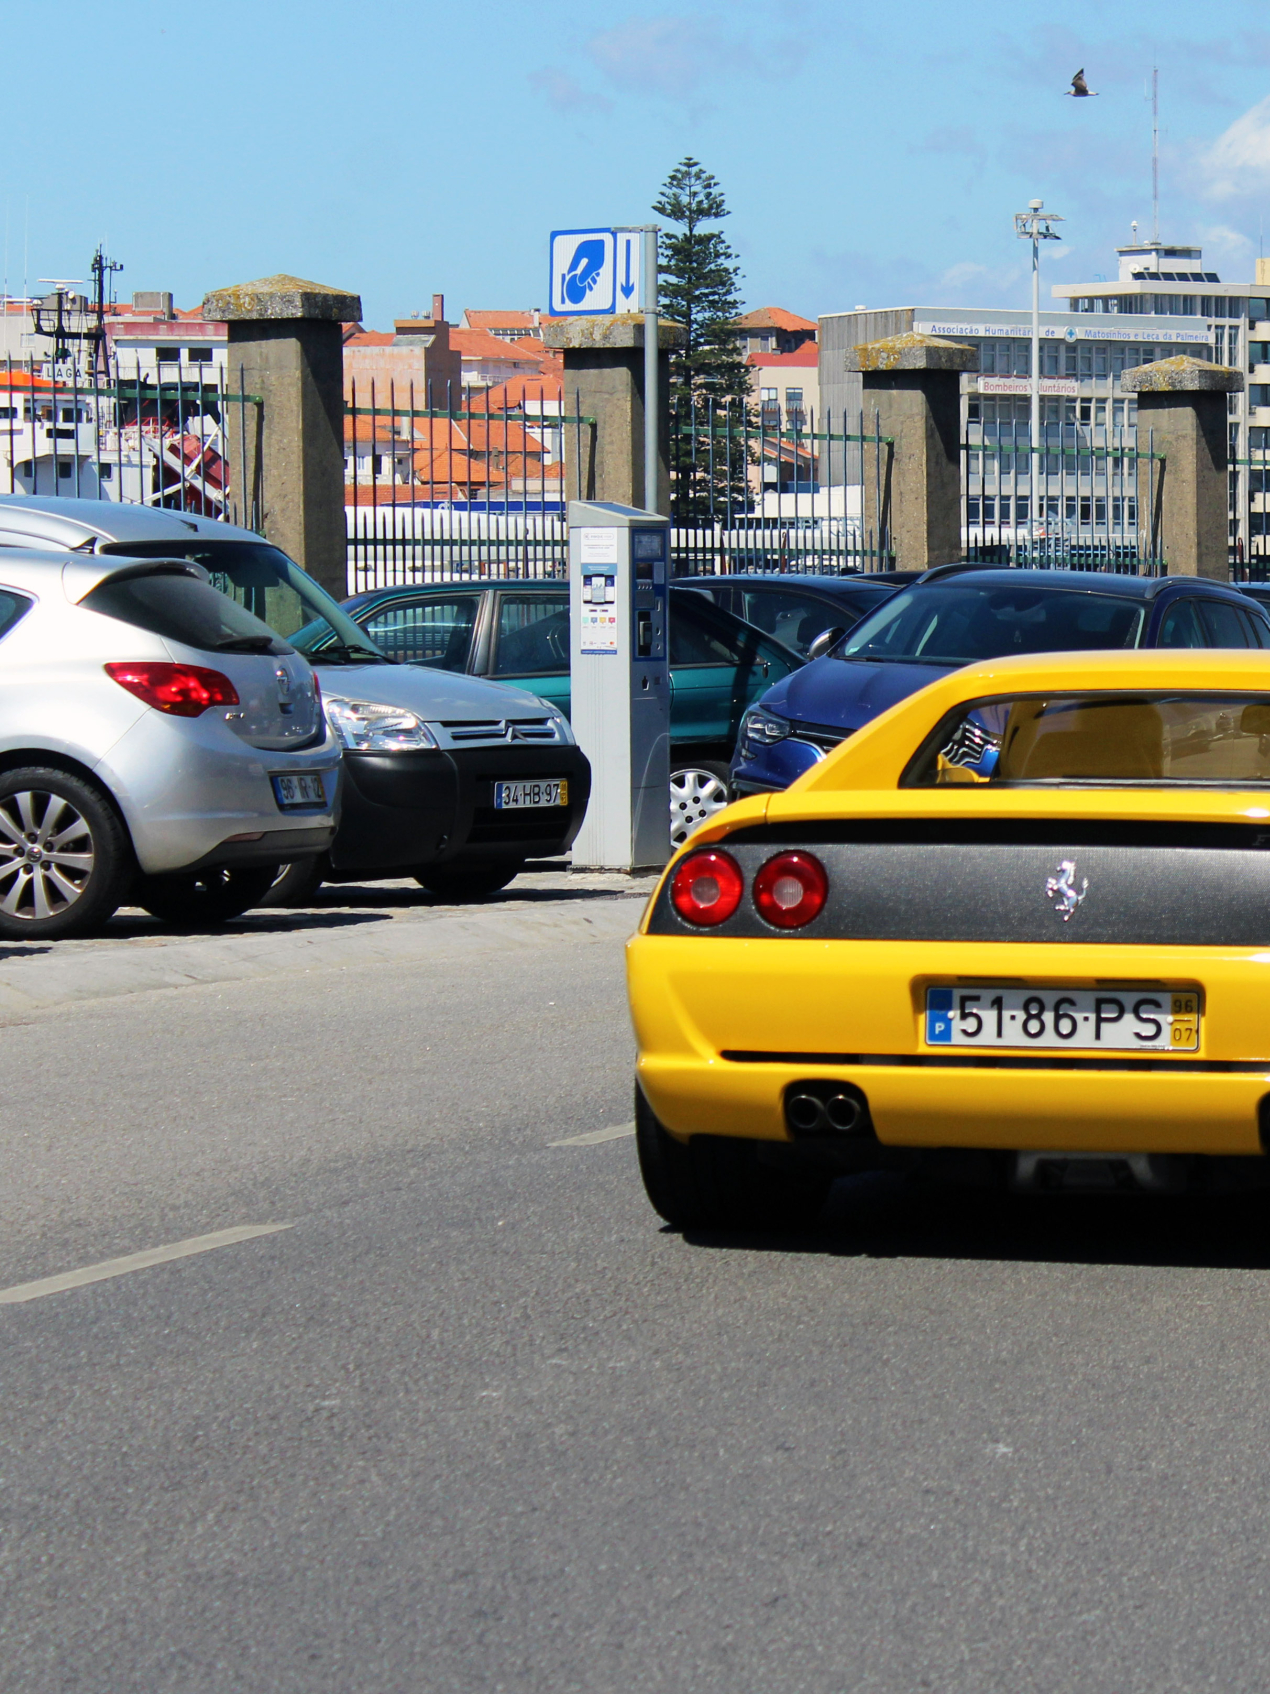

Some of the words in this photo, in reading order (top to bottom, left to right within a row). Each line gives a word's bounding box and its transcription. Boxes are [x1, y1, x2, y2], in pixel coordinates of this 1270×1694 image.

[930, 324, 980, 336] Associação
[1044, 328, 1056, 337] de
[1084, 329, 1131, 340] Matosinhos
[1133, 332, 1139, 340] e
[1142, 331, 1160, 341] Leça
[1162, 331, 1172, 341] da
[1175, 332, 1210, 342] Palmeira
[46, 366, 83, 378] LAGA
[983, 381, 1028, 392] Bombeiros
[1029, 382, 1076, 394] Vluntários
[1173, 999, 1194, 1014] 96
[935, 1023, 946, 1035] P
[1173, 1027, 1193, 1041] 07
